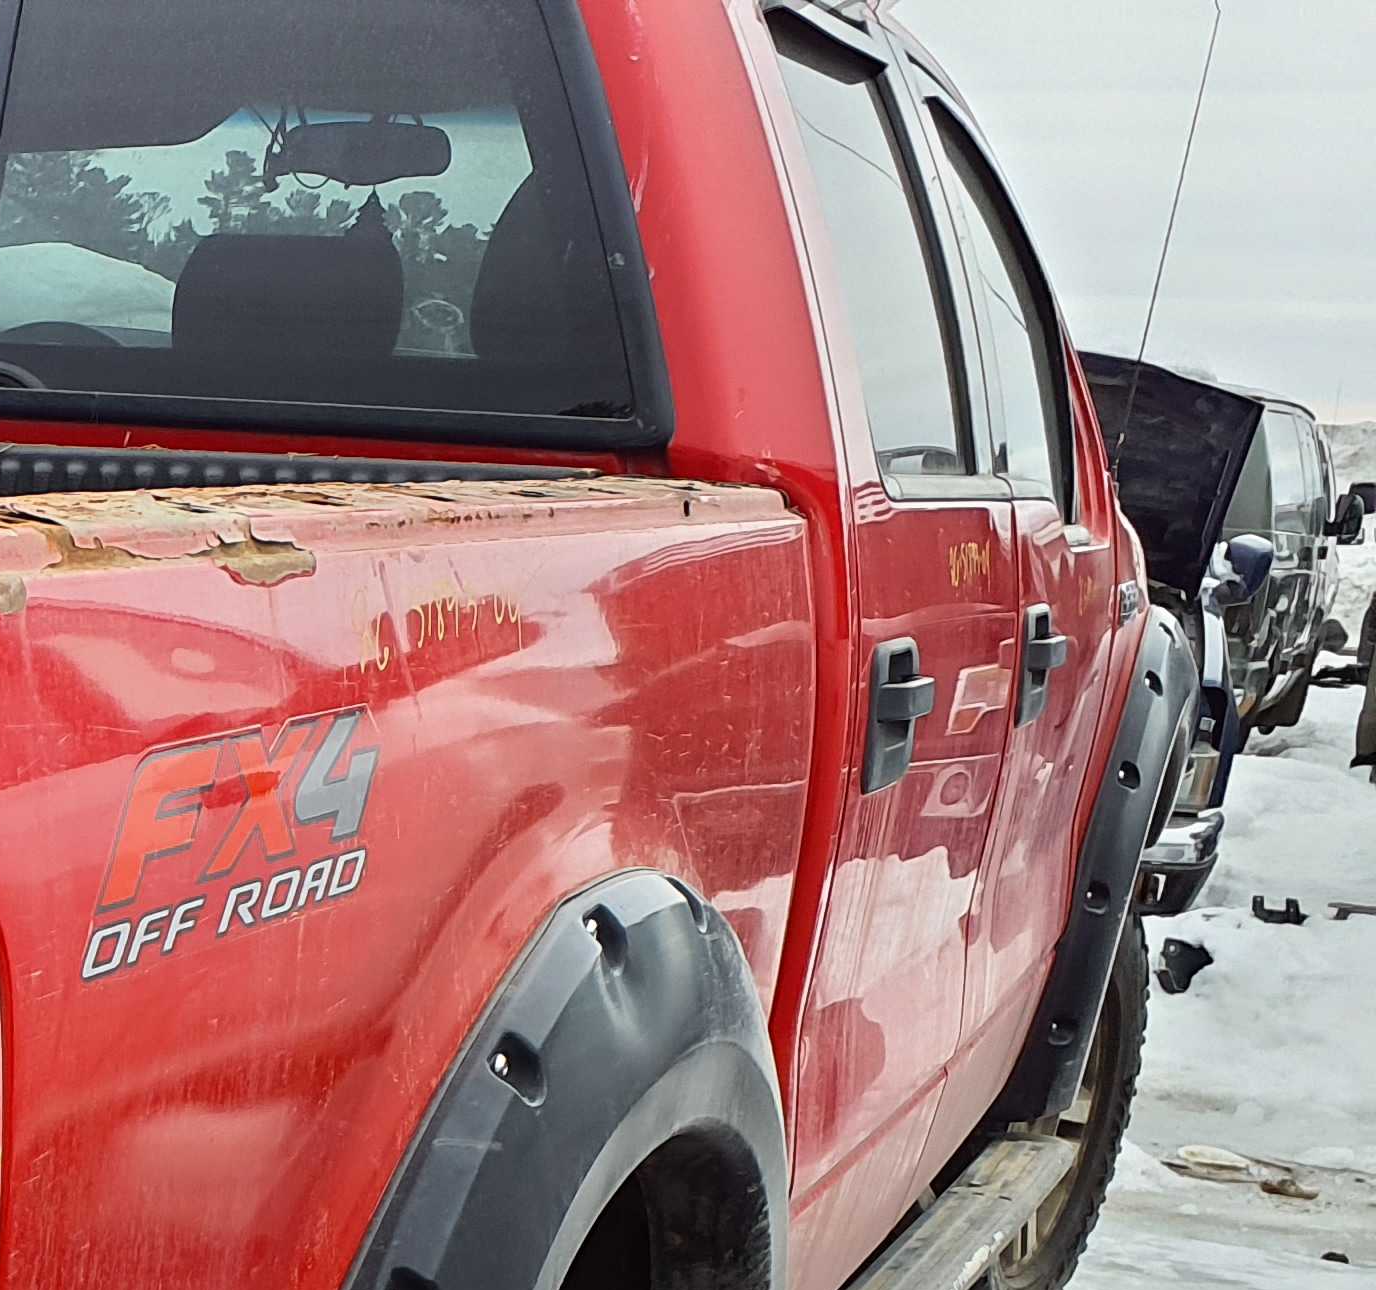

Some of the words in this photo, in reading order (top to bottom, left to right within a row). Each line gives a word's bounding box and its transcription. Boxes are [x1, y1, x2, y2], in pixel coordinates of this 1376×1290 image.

[96, 708, 379, 914] FX4
[81, 896, 206, 981] OFF
[215, 848, 367, 937] ROAD
